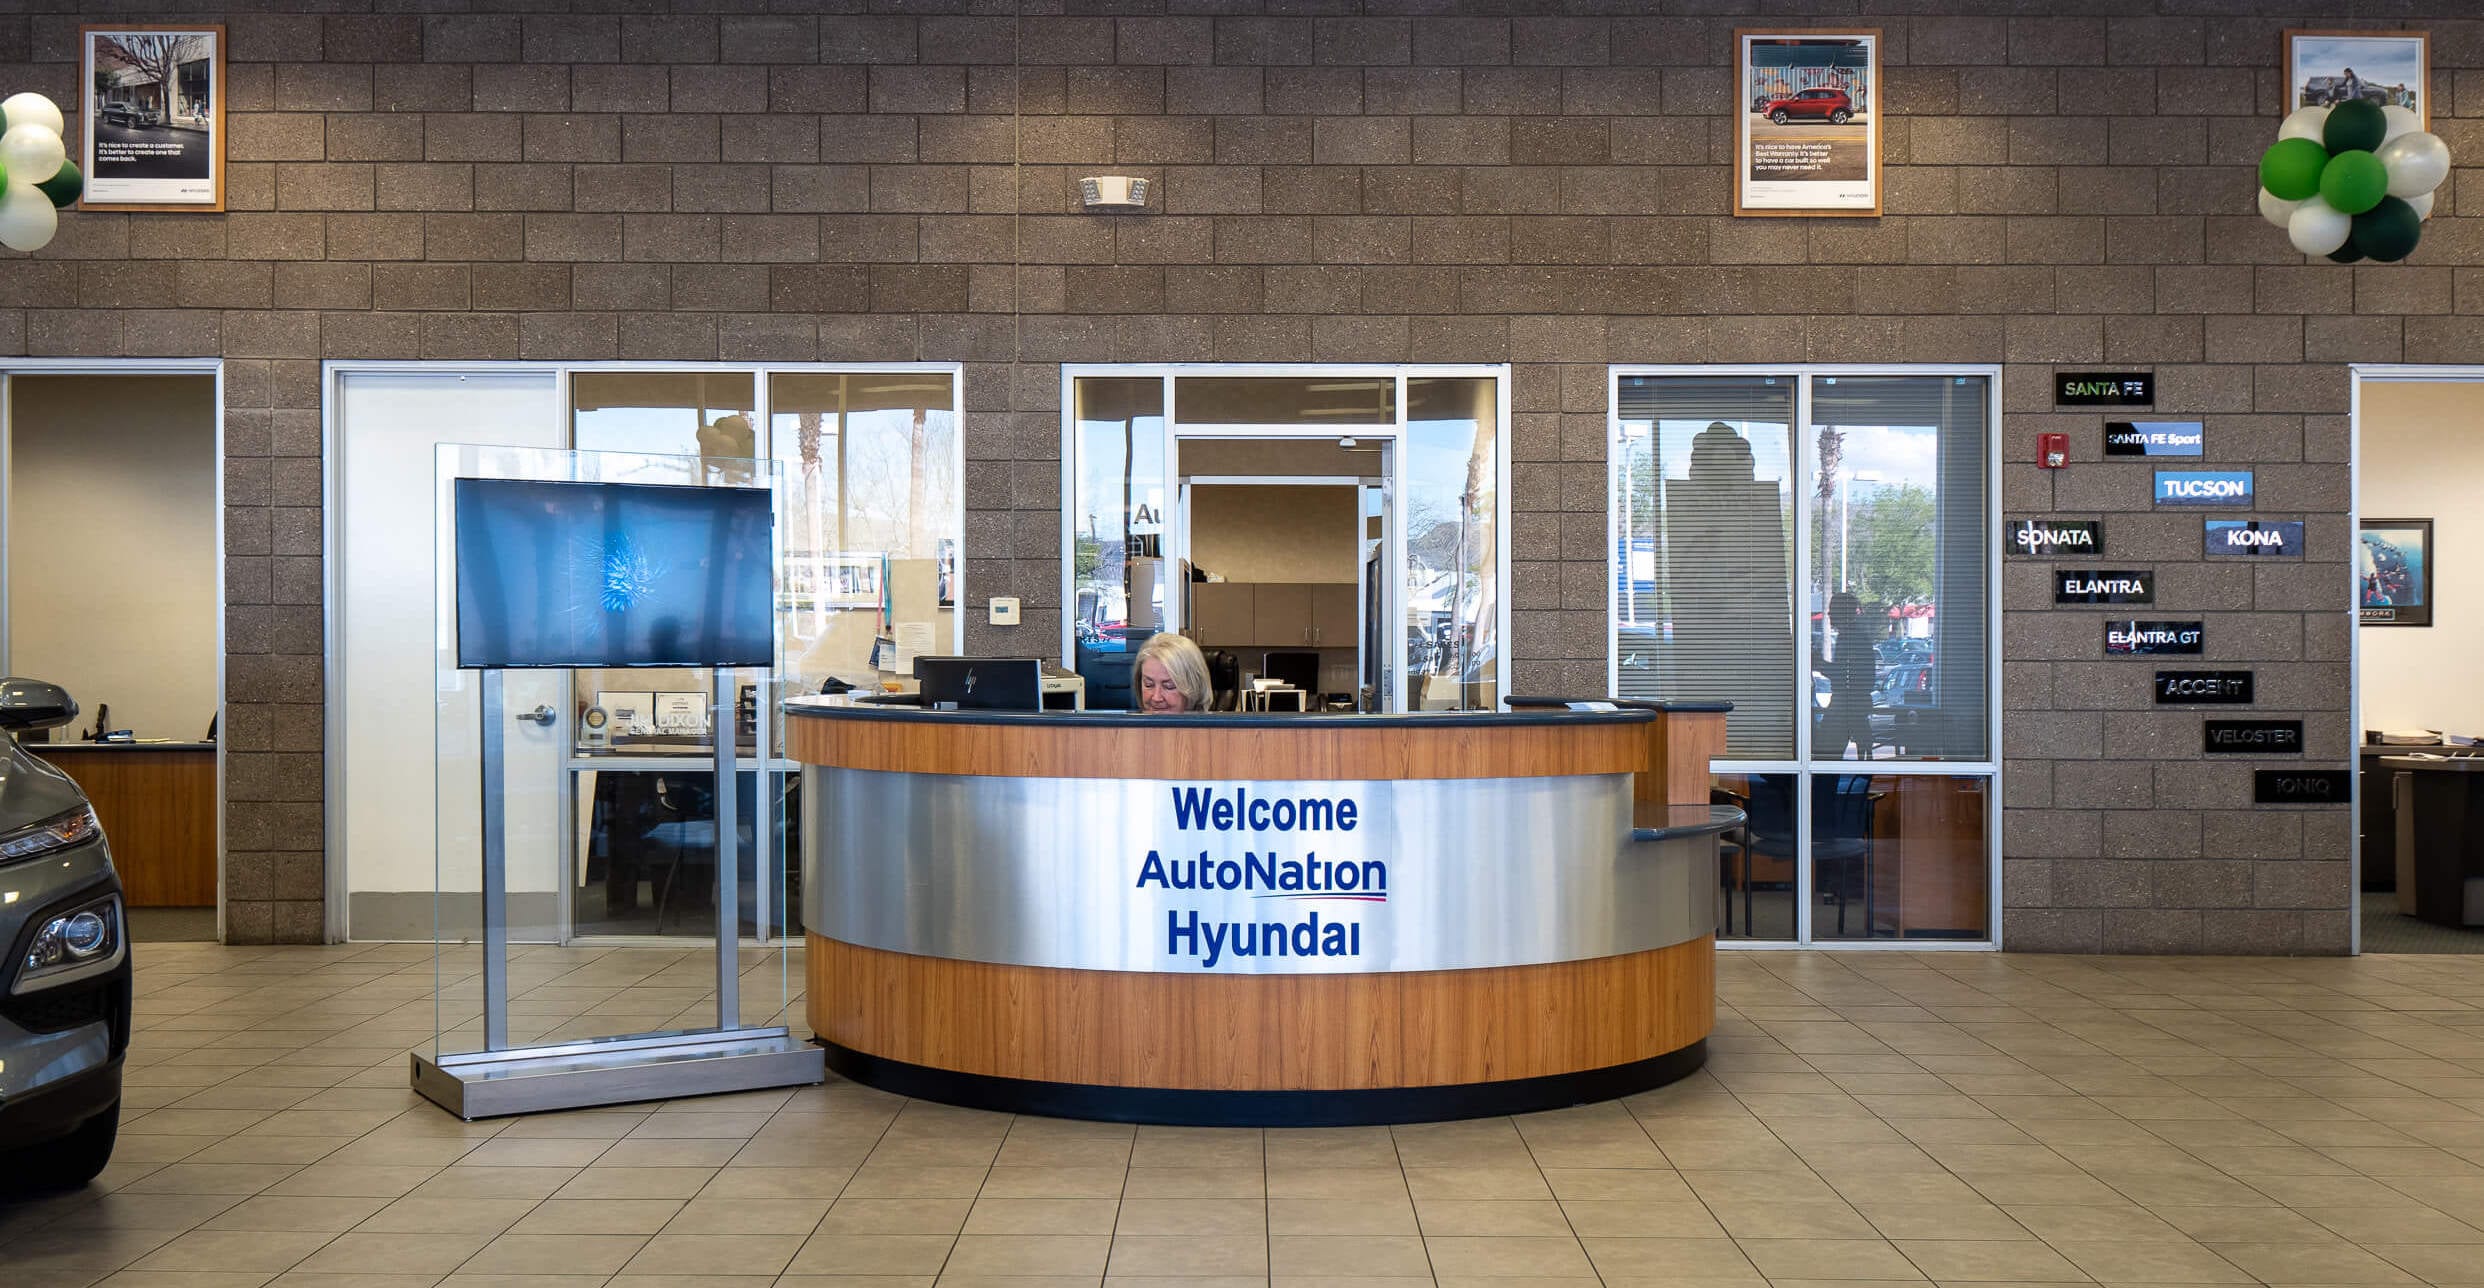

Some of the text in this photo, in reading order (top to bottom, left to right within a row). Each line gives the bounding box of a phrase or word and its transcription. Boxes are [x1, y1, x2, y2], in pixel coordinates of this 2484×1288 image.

[2064, 382, 2144, 396] SANTA FE
[2108, 434, 2201, 446] SANTA FE Sport
[2164, 480, 2244, 496] TUCSON
[2016, 529, 2093, 546] SONATA
[2227, 530, 2284, 546] KONA
[2065, 580, 2144, 594] ELANTRA
[2108, 631, 2200, 644] ELANTRA GT
[2165, 680, 2244, 696] ACCENT
[2210, 730, 2297, 744] VELOSTER
[1172, 786, 1358, 831] Welcome
[1136, 850, 1387, 890] AutoNation
[1168, 910, 1360, 968] Hyundai
